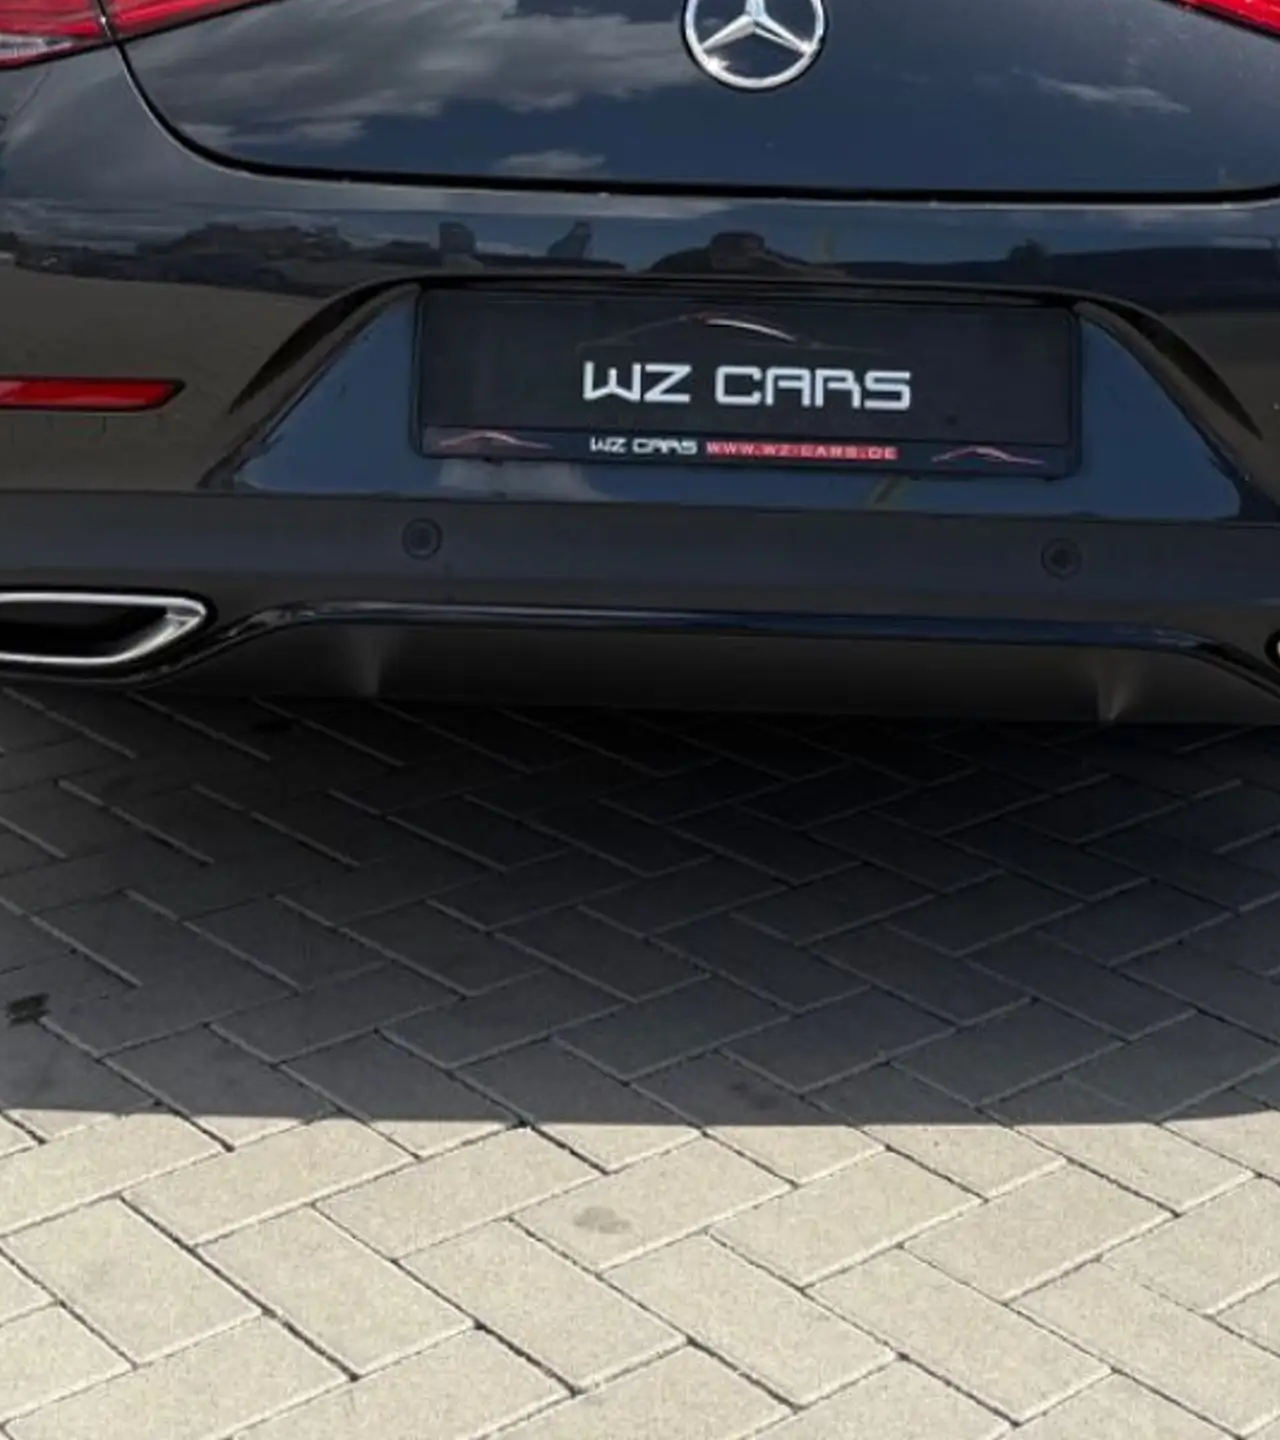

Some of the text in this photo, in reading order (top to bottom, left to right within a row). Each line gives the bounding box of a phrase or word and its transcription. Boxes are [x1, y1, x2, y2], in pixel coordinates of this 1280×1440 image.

[582, 360, 912, 410] WZ CARS
[589, 436, 628, 453] WZ
[631, 437, 698, 455] CARS
